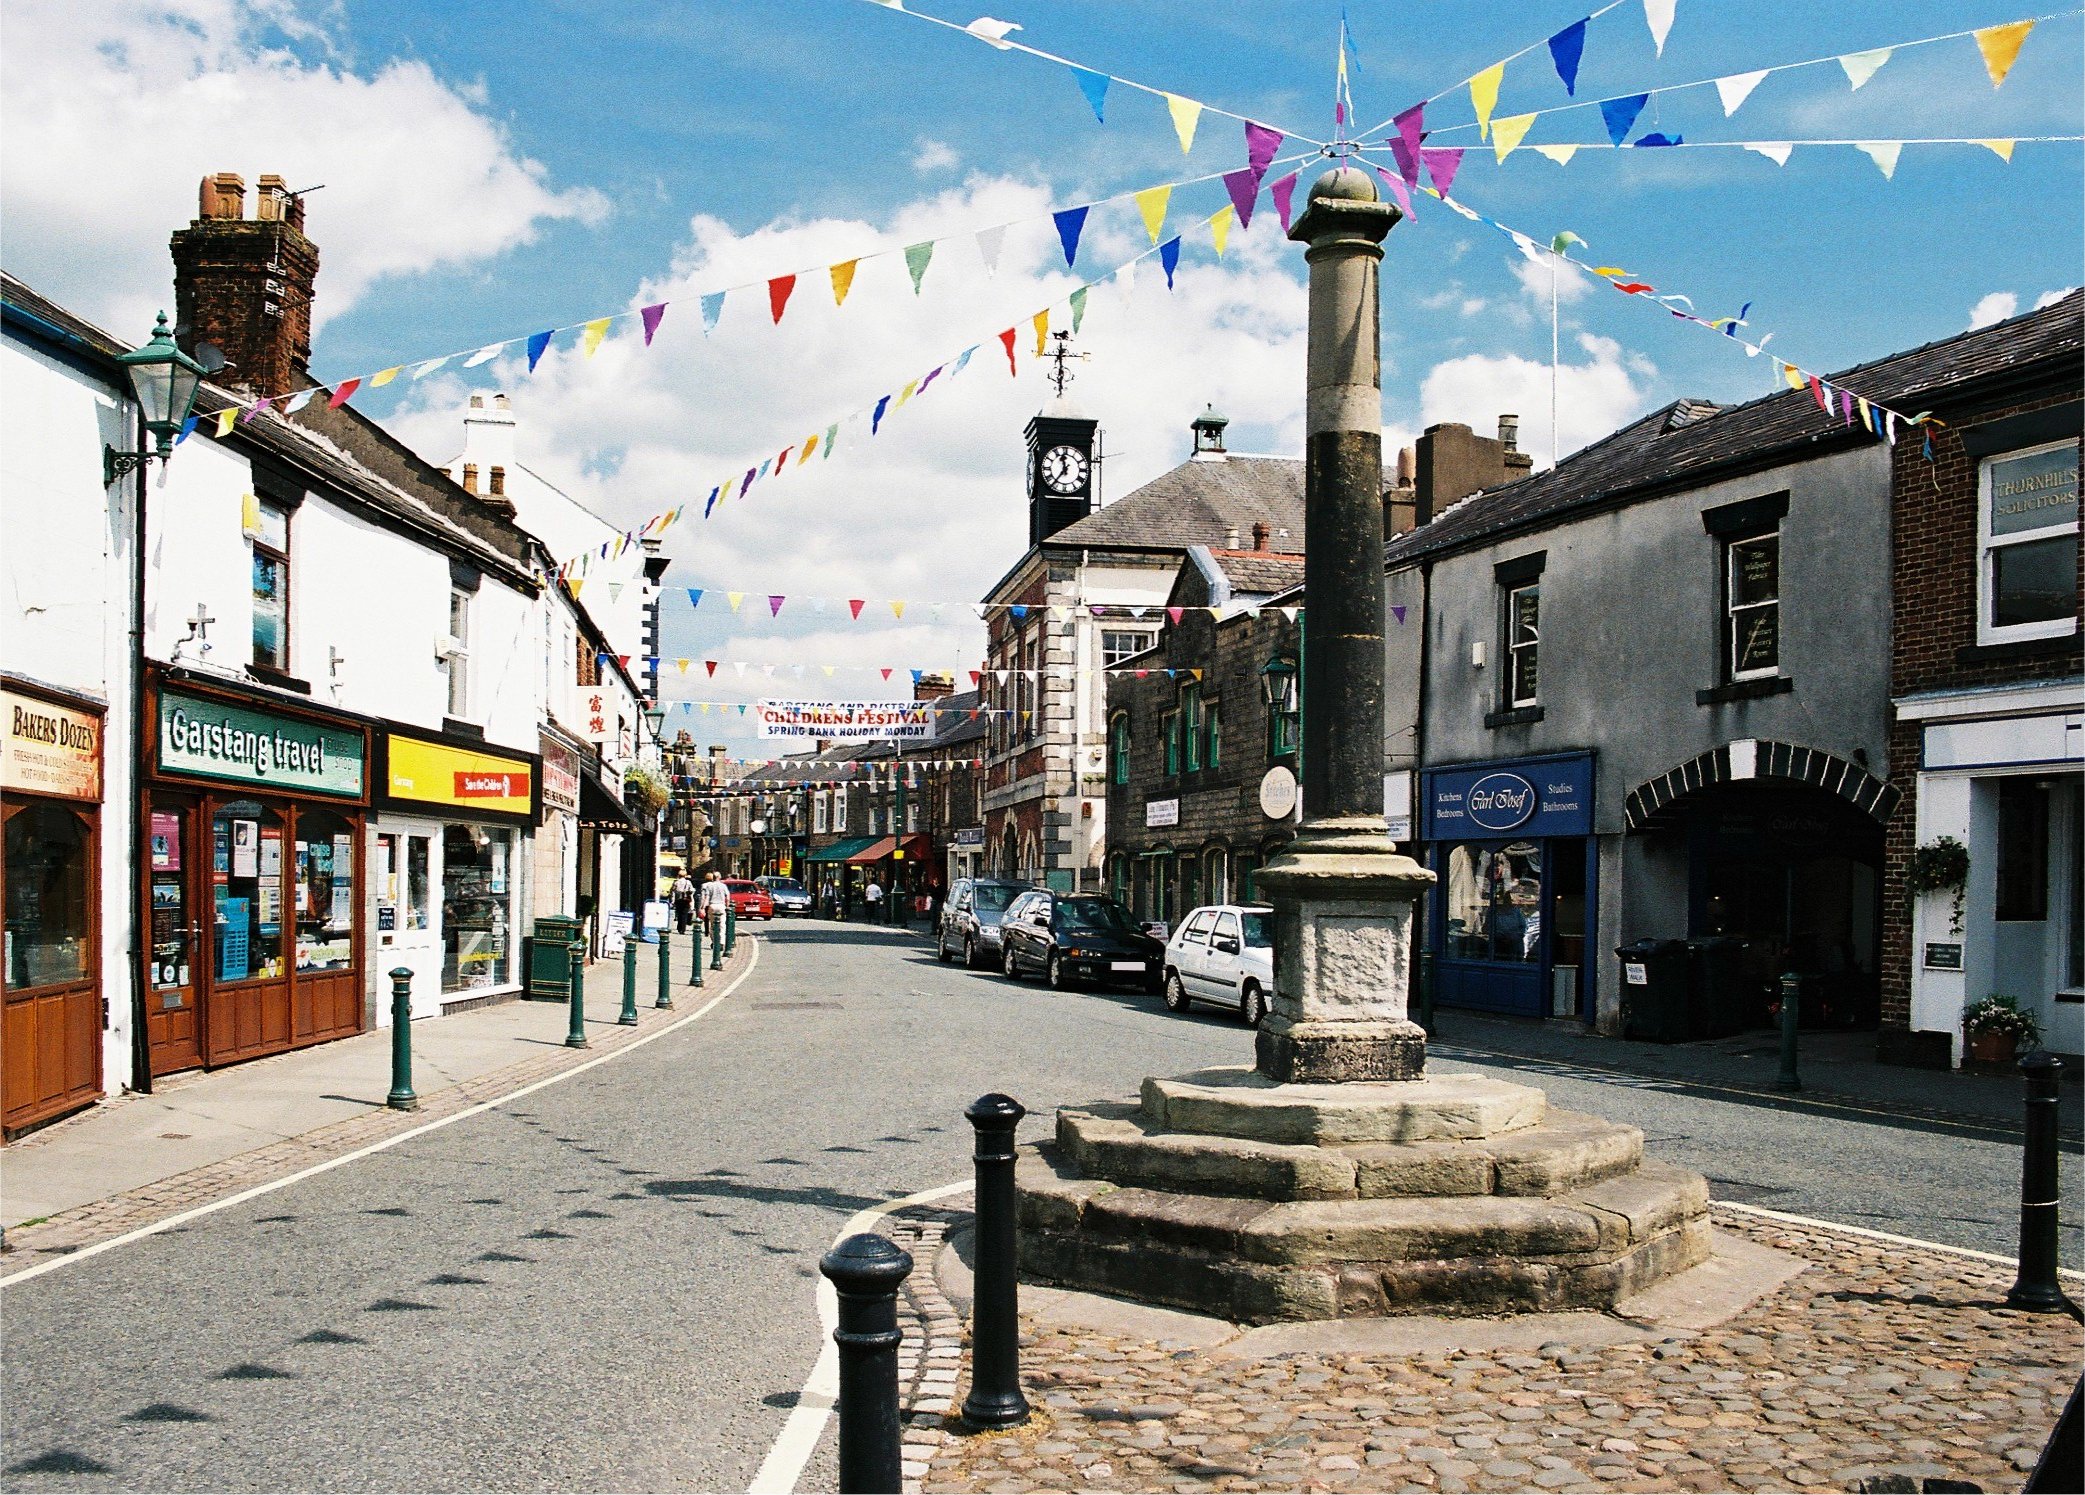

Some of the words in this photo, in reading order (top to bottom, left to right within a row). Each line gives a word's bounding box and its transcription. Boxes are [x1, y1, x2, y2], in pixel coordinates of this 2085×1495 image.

[1995, 467, 2078, 497] THURNHILLS
[1997, 491, 2076, 515] SOLICITORS
[764, 711, 853, 725] CHILDRENS
[857, 710, 929, 725] FESTIVAL
[13, 705, 57, 744] BAKERS
[60, 718, 94, 751] DOZEN
[768, 726, 805, 736] SPRING
[808, 727, 836, 737] BANK
[839, 727, 881, 736] HOLIDAY
[884, 726, 926, 736] MONDAY
[171, 707, 270, 776] Garstang
[274, 728, 325, 775] travel
[1548, 783, 1573, 794] Studies
[1438, 792, 1462, 802] Kitchens
[1471, 790, 1494, 811] Carl
[1543, 800, 1578, 812] Bathrooms
[1437, 809, 1464, 818] Bedrooms
[540, 928, 567, 938] LITTER
